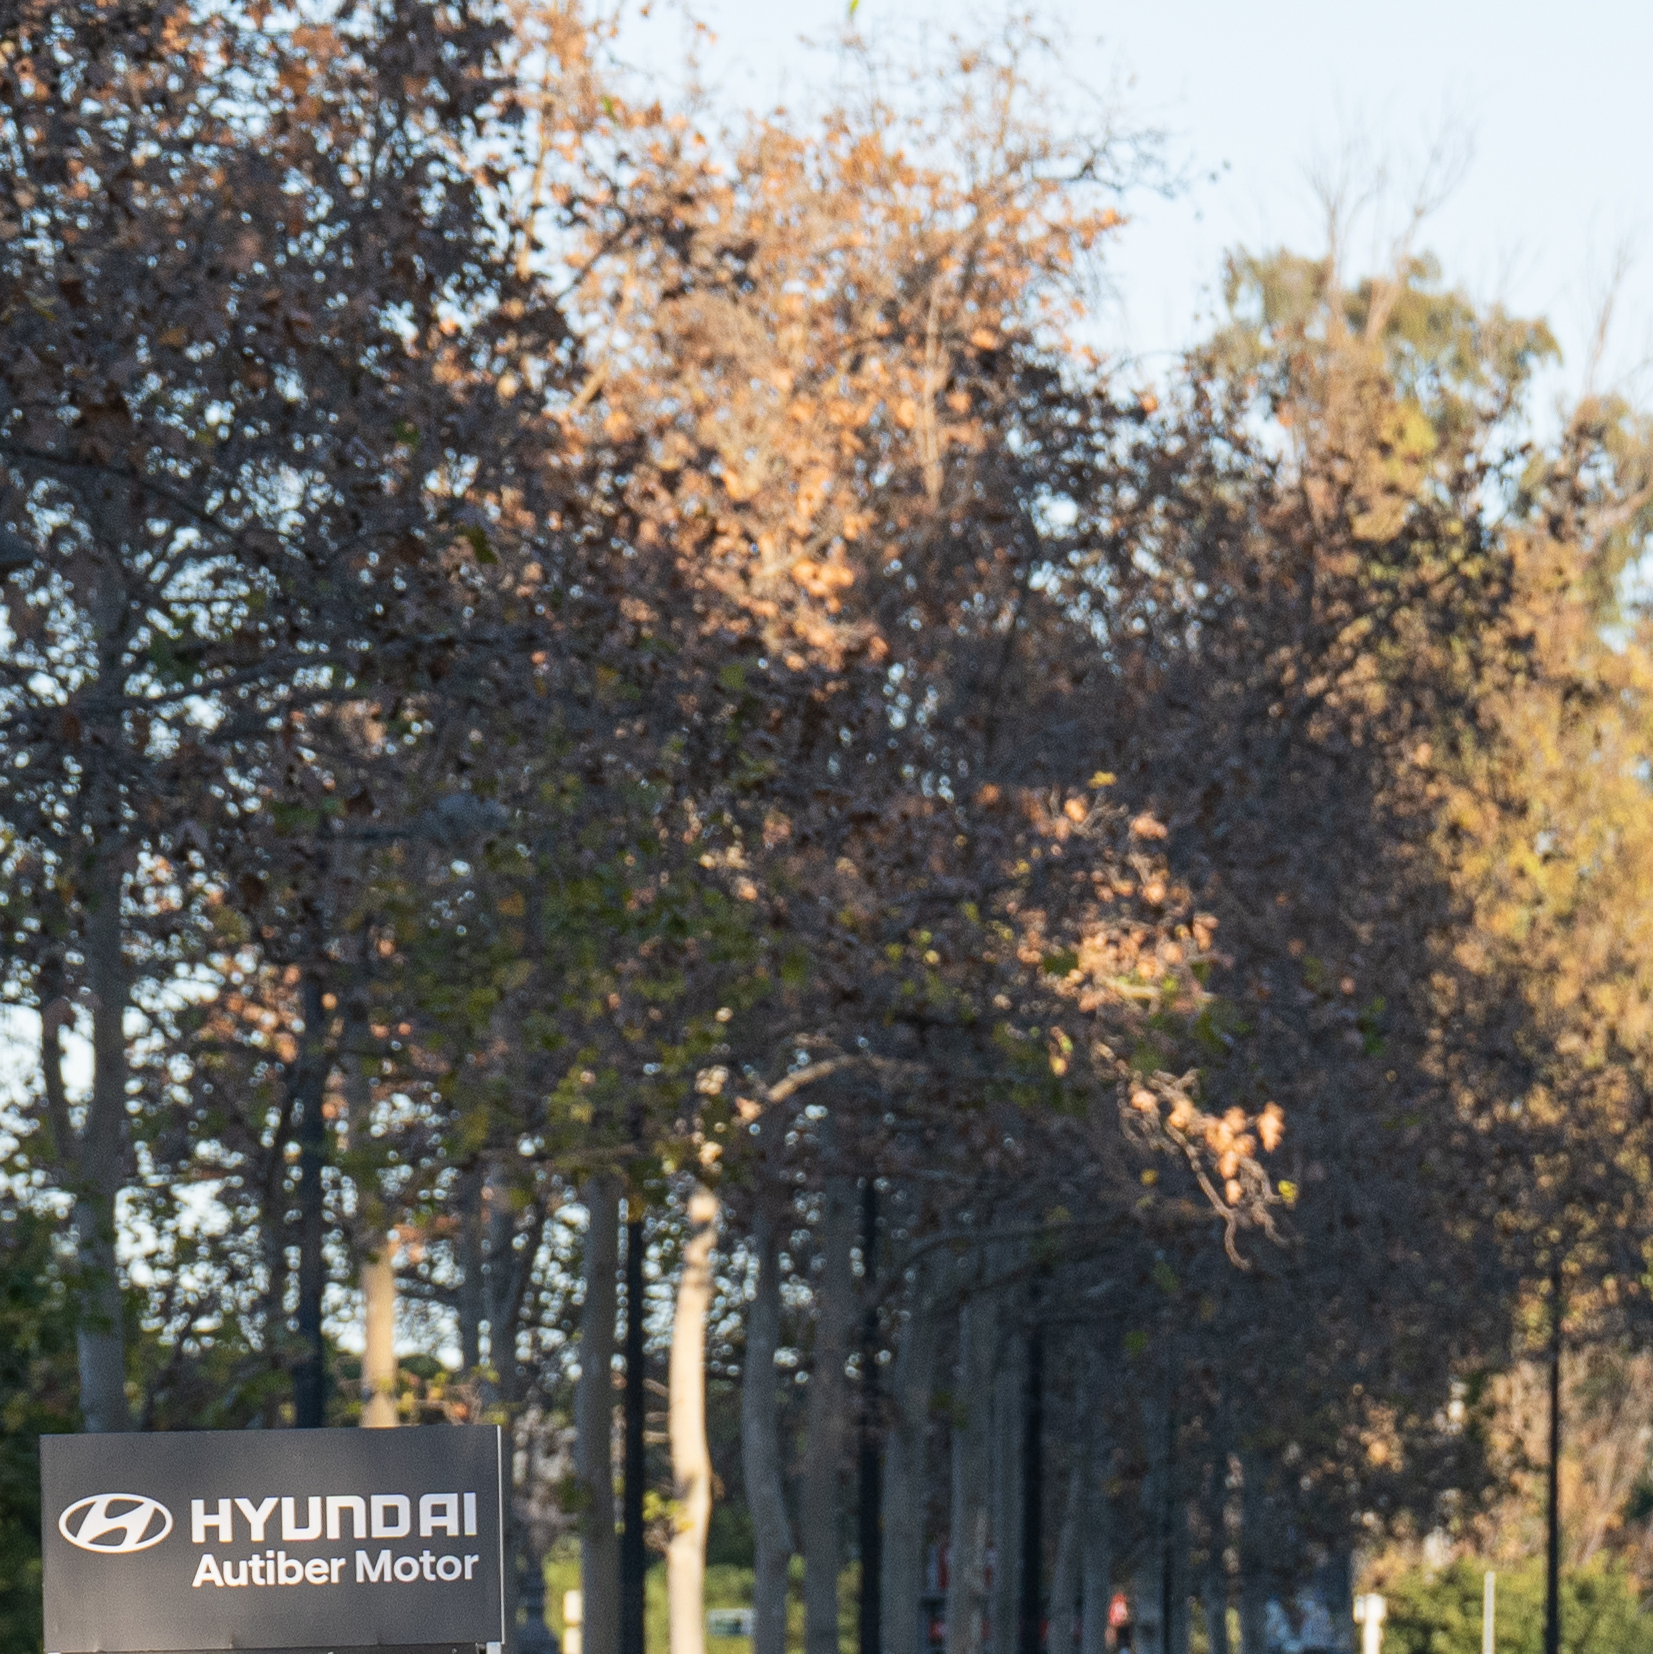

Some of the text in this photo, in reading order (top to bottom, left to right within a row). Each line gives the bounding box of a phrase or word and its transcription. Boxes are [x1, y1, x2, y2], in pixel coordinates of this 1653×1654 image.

[191, 1492, 477, 1543] HYUNDAI
[191, 1548, 479, 1588] Autiber Motor
